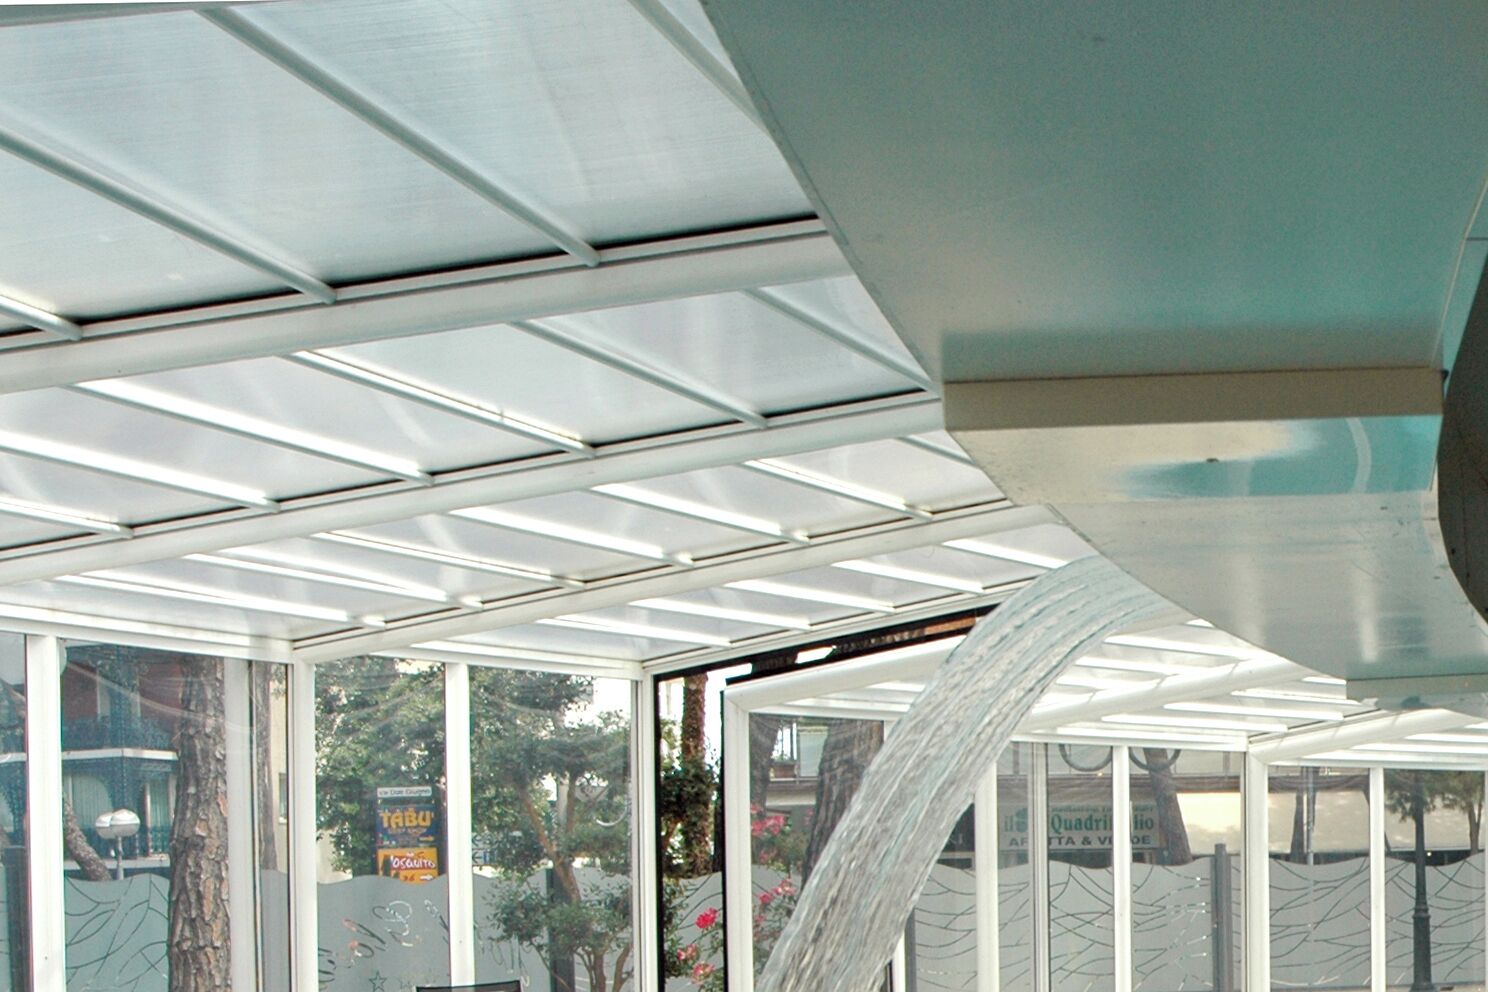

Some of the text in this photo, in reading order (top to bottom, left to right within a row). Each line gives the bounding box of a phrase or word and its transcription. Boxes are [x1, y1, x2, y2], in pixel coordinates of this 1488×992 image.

[1051, 813, 1154, 834] Quadrilio
[1008, 835, 1151, 847] AFTTA & VDE
